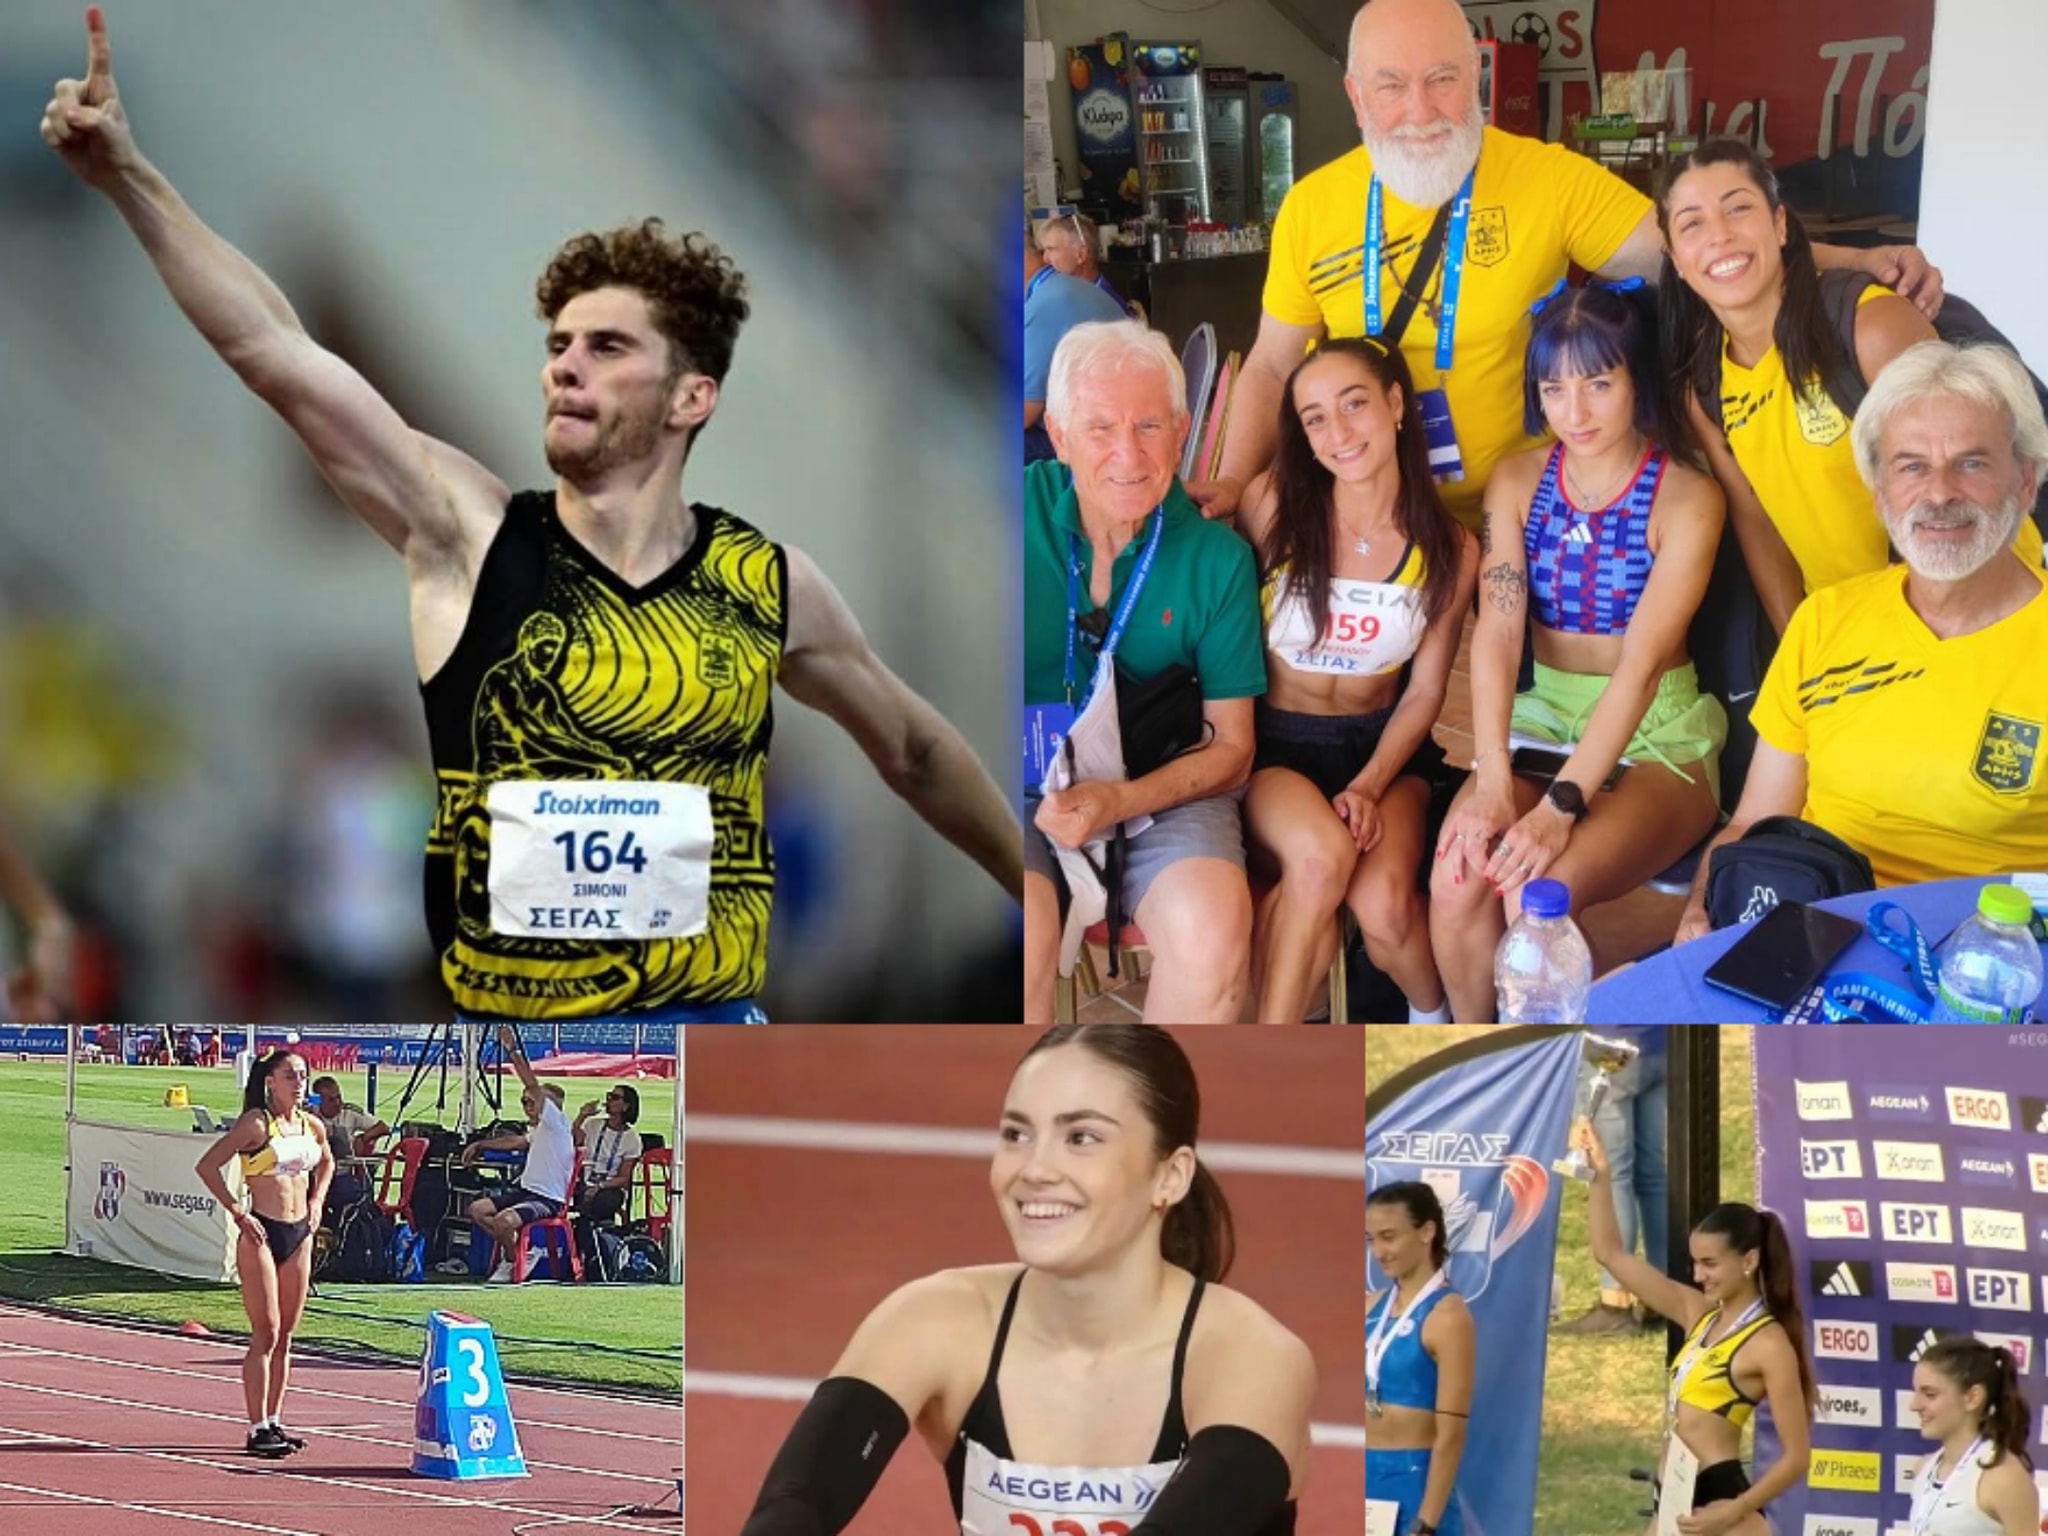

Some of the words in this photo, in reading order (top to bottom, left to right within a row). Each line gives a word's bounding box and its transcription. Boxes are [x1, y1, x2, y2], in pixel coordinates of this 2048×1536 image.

[533, 789, 660, 816] Stoiximan
[553, 830, 649, 874] 164
[529, 907, 622, 929] ΣΕΓΑΣ
[1869, 1095, 1918, 1110] AEGEAN
[1953, 1096, 2002, 1121] ERGO
[1376, 1132, 1511, 1164] ΣΕΓΑΣ
[1960, 1159, 2006, 1174] AEGEAN
[1820, 1327, 1870, 1353] ERGO
[458, 1338, 490, 1407] 3
[1830, 1459, 1878, 1480] Piraeus
[988, 1470, 1123, 1504] AEGEAN
